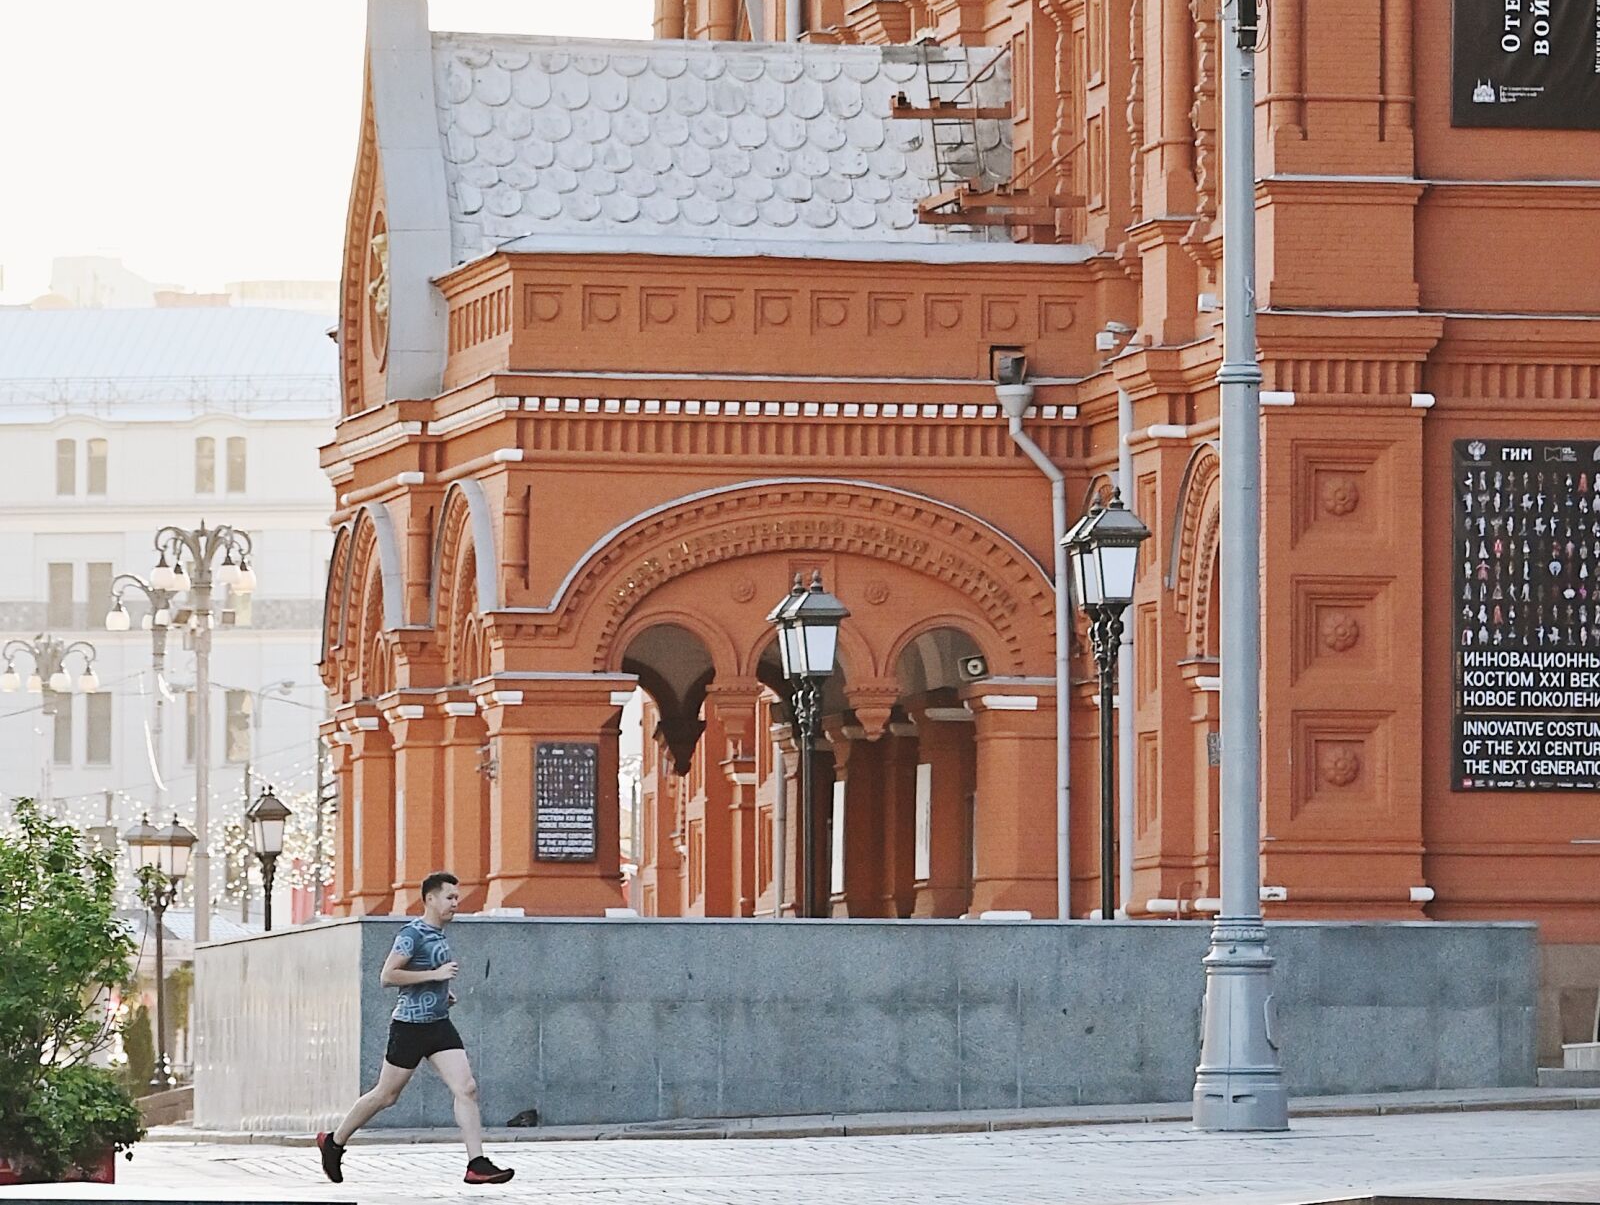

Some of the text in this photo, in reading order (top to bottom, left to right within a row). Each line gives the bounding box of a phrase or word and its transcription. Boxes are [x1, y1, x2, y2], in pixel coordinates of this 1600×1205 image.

[1501, 447, 1532, 462] ГИМ
[1463, 671, 1534, 688] КОСТЮМ
[1539, 672, 1566, 688] XXI
[1463, 691, 1517, 707] НОВОЕ
[1463, 721, 1544, 737] INNOVATIVE
[1462, 740, 1481, 756] OF
[1485, 740, 1514, 756] THE
[1517, 740, 1541, 756] XXI
[1463, 759, 1490, 775] THE
[1493, 759, 1528, 775] NEXT
